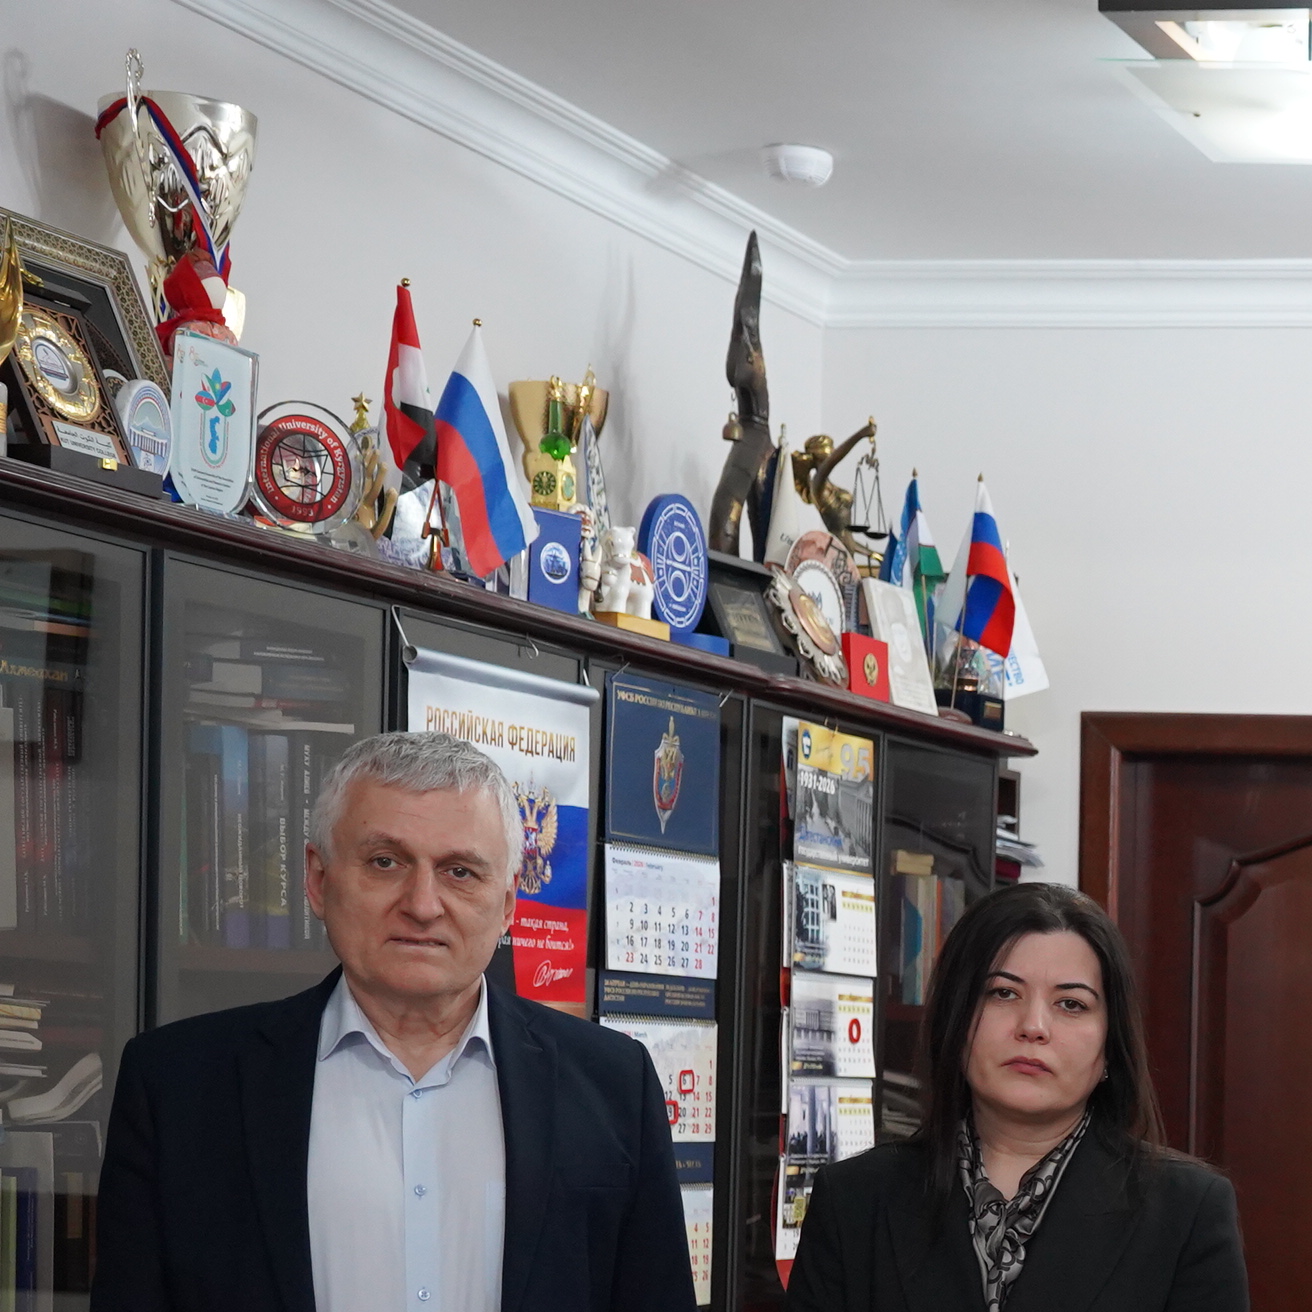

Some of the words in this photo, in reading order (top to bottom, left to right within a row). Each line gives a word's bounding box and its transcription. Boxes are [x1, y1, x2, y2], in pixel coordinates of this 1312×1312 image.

[278, 419, 328, 440] University
[327, 437, 339, 449] of
[426, 705, 504, 748] РОССИЙСКАЯ
[507, 724, 577, 762] ФЕДЕРАЦИЯ
[840, 743, 870, 783] 95
[800, 770, 835, 795] 1931-2026
[279, 864, 287, 907] КУРСА
[641, 920, 648, 931] 10
[654, 922, 661, 932] 11
[668, 924, 675, 934] 12
[682, 926, 689, 936] 13
[695, 927, 703, 937] 14
[708, 928, 715, 939] 15
[512, 936, 536, 948] ничего
[626, 936, 634, 946] 16
[641, 937, 648, 947] 17
[654, 939, 661, 949] 18
[668, 940, 675, 950] 19
[681, 942, 689, 952] 20
[695, 943, 703, 953] 21
[708, 944, 714, 955] 22
[626, 952, 634, 963] 23
[640, 954, 648, 964] 24
[654, 955, 662, 965] 25
[668, 957, 675, 967] 26
[681, 958, 689, 968] 27
[695, 959, 702, 969] 28
[693, 1091, 699, 1101] 14
[705, 1092, 712, 1102] 15
[679, 1107, 686, 1117] 20
[692, 1107, 699, 1117] 21
[705, 1108, 711, 1118] 22
[678, 1123, 686, 1133] 27
[692, 1124, 699, 1133] 28
[705, 1124, 711, 1134] 29
[691, 1240, 697, 1249] 11
[703, 1239, 709, 1249] 12
